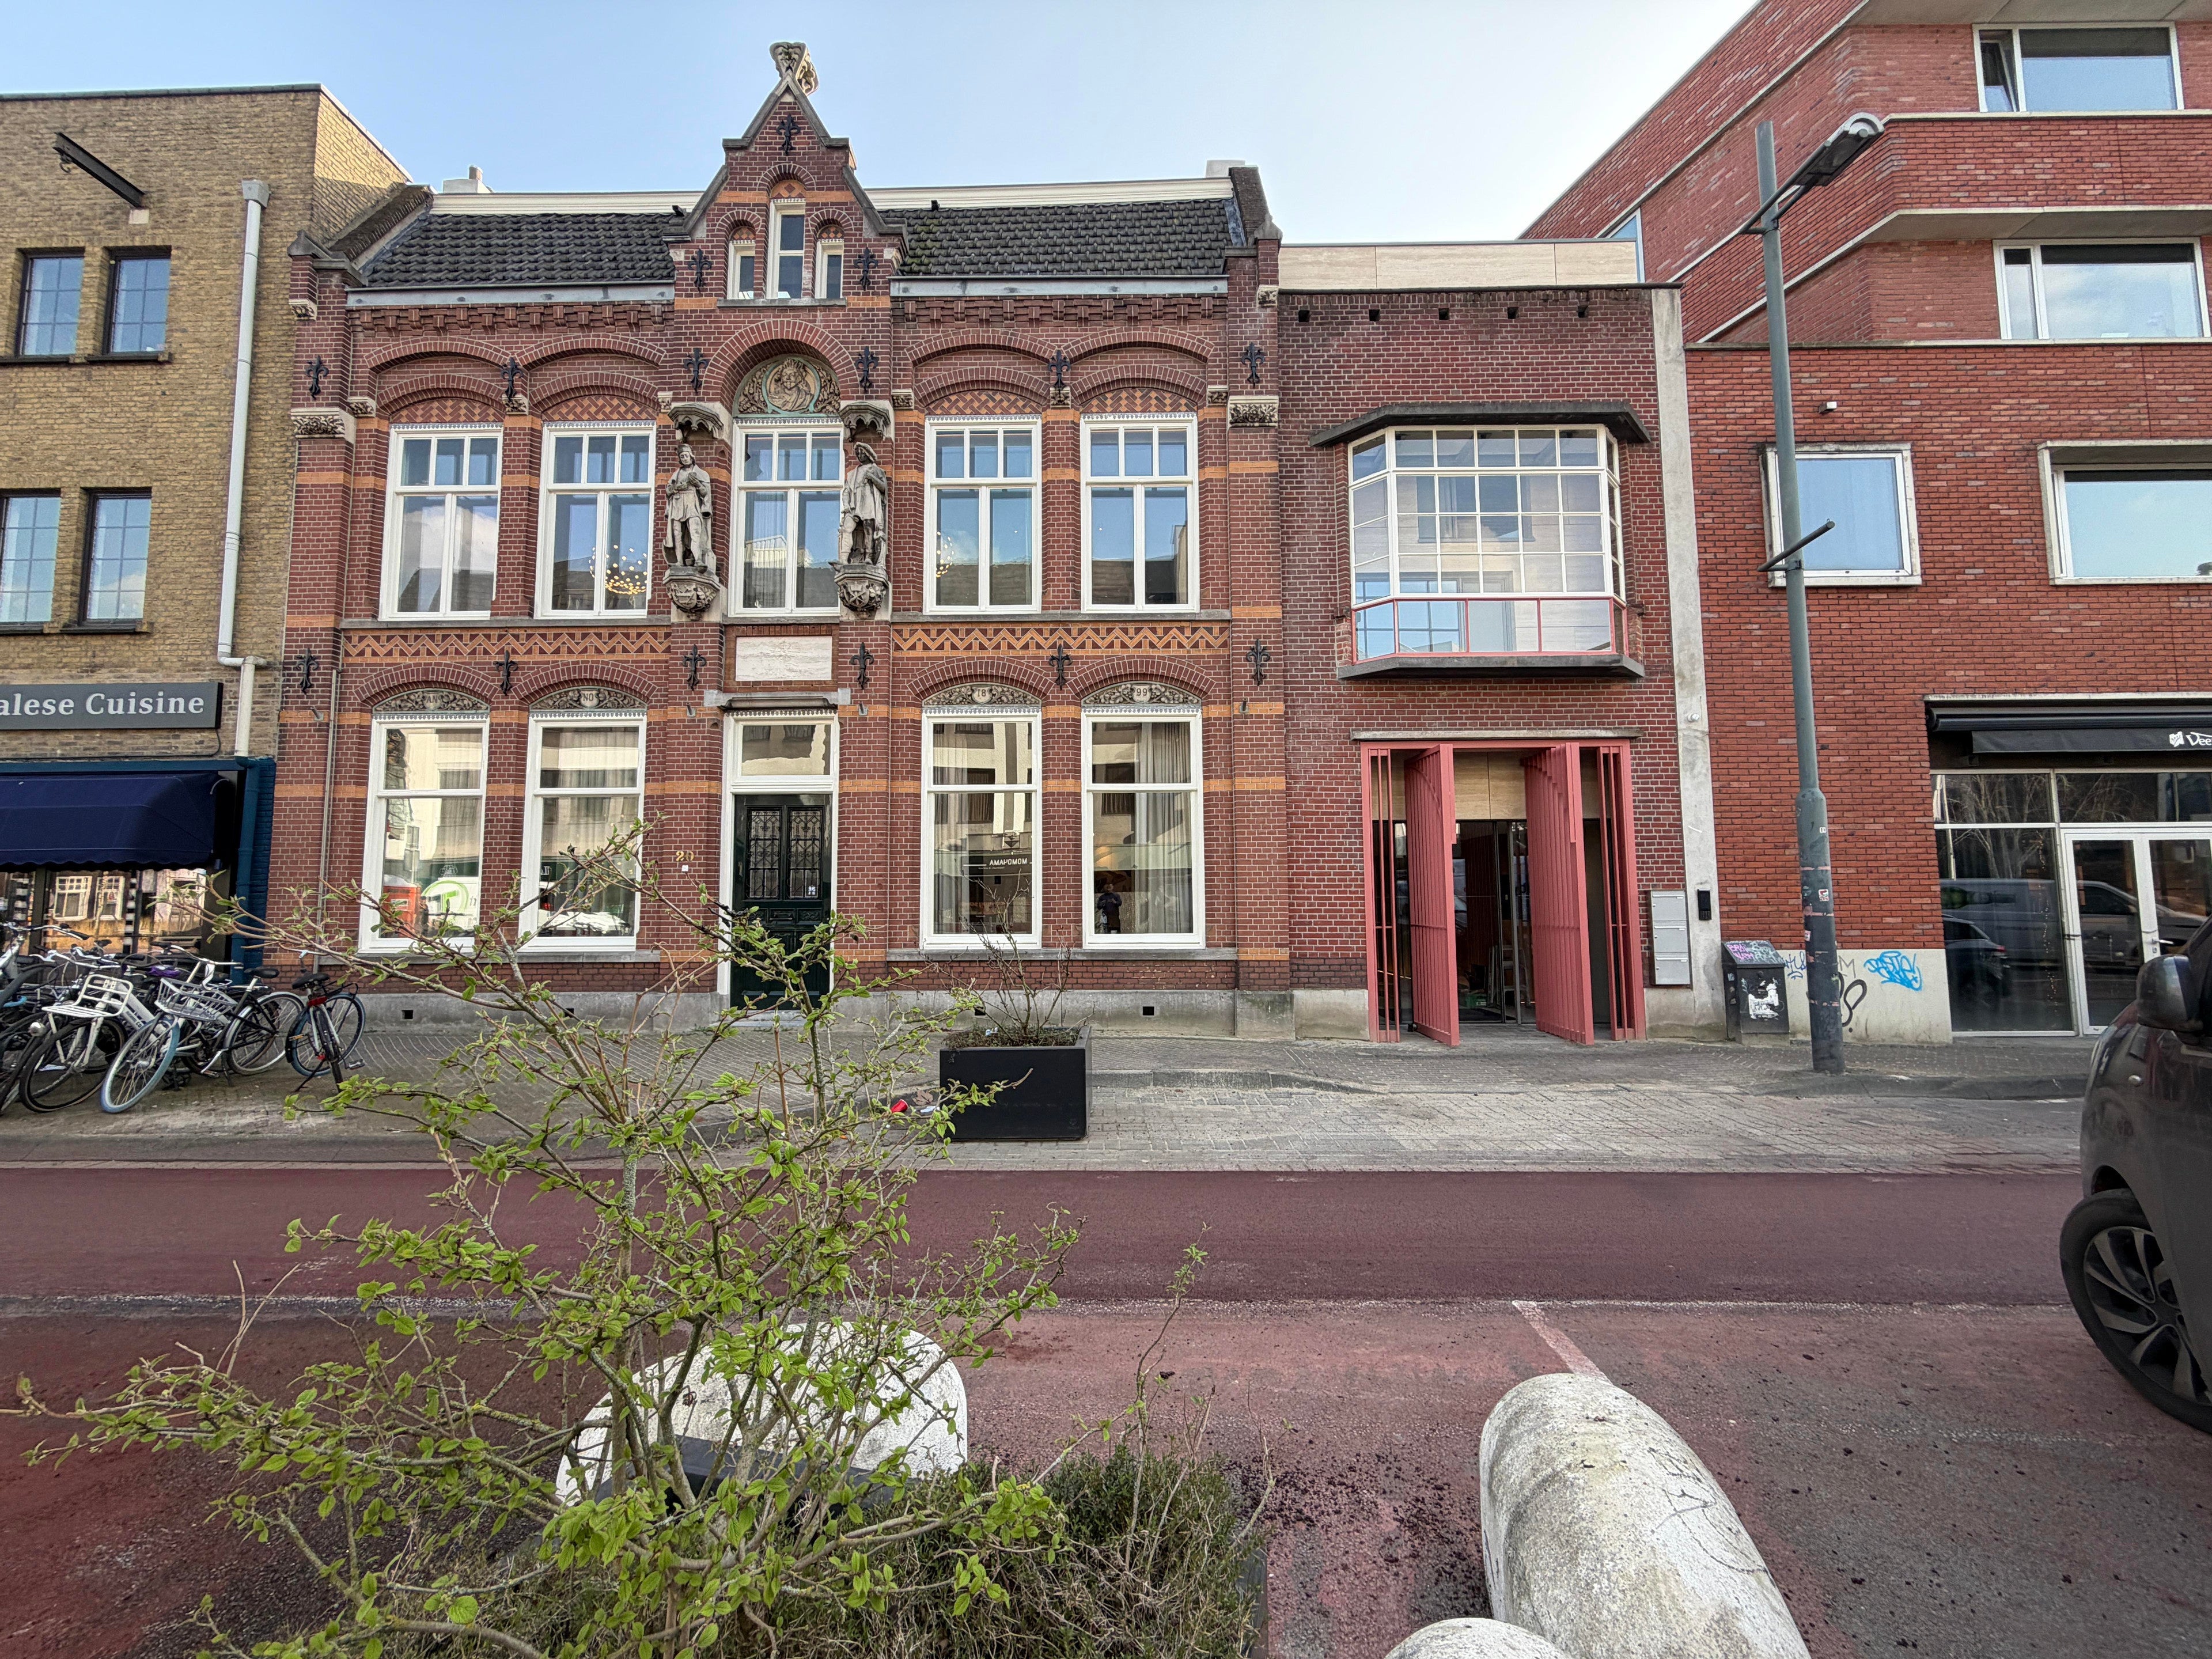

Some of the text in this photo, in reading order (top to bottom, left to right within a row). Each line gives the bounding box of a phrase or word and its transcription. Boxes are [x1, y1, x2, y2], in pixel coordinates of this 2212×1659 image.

[977, 689, 986, 697] 18
[1137, 688, 1147, 696] 99
[426, 695, 438, 703] AN
[582, 693, 594, 702] NO
[0, 691, 204, 716] alese Cuisine
[676, 851, 694, 861] 20
